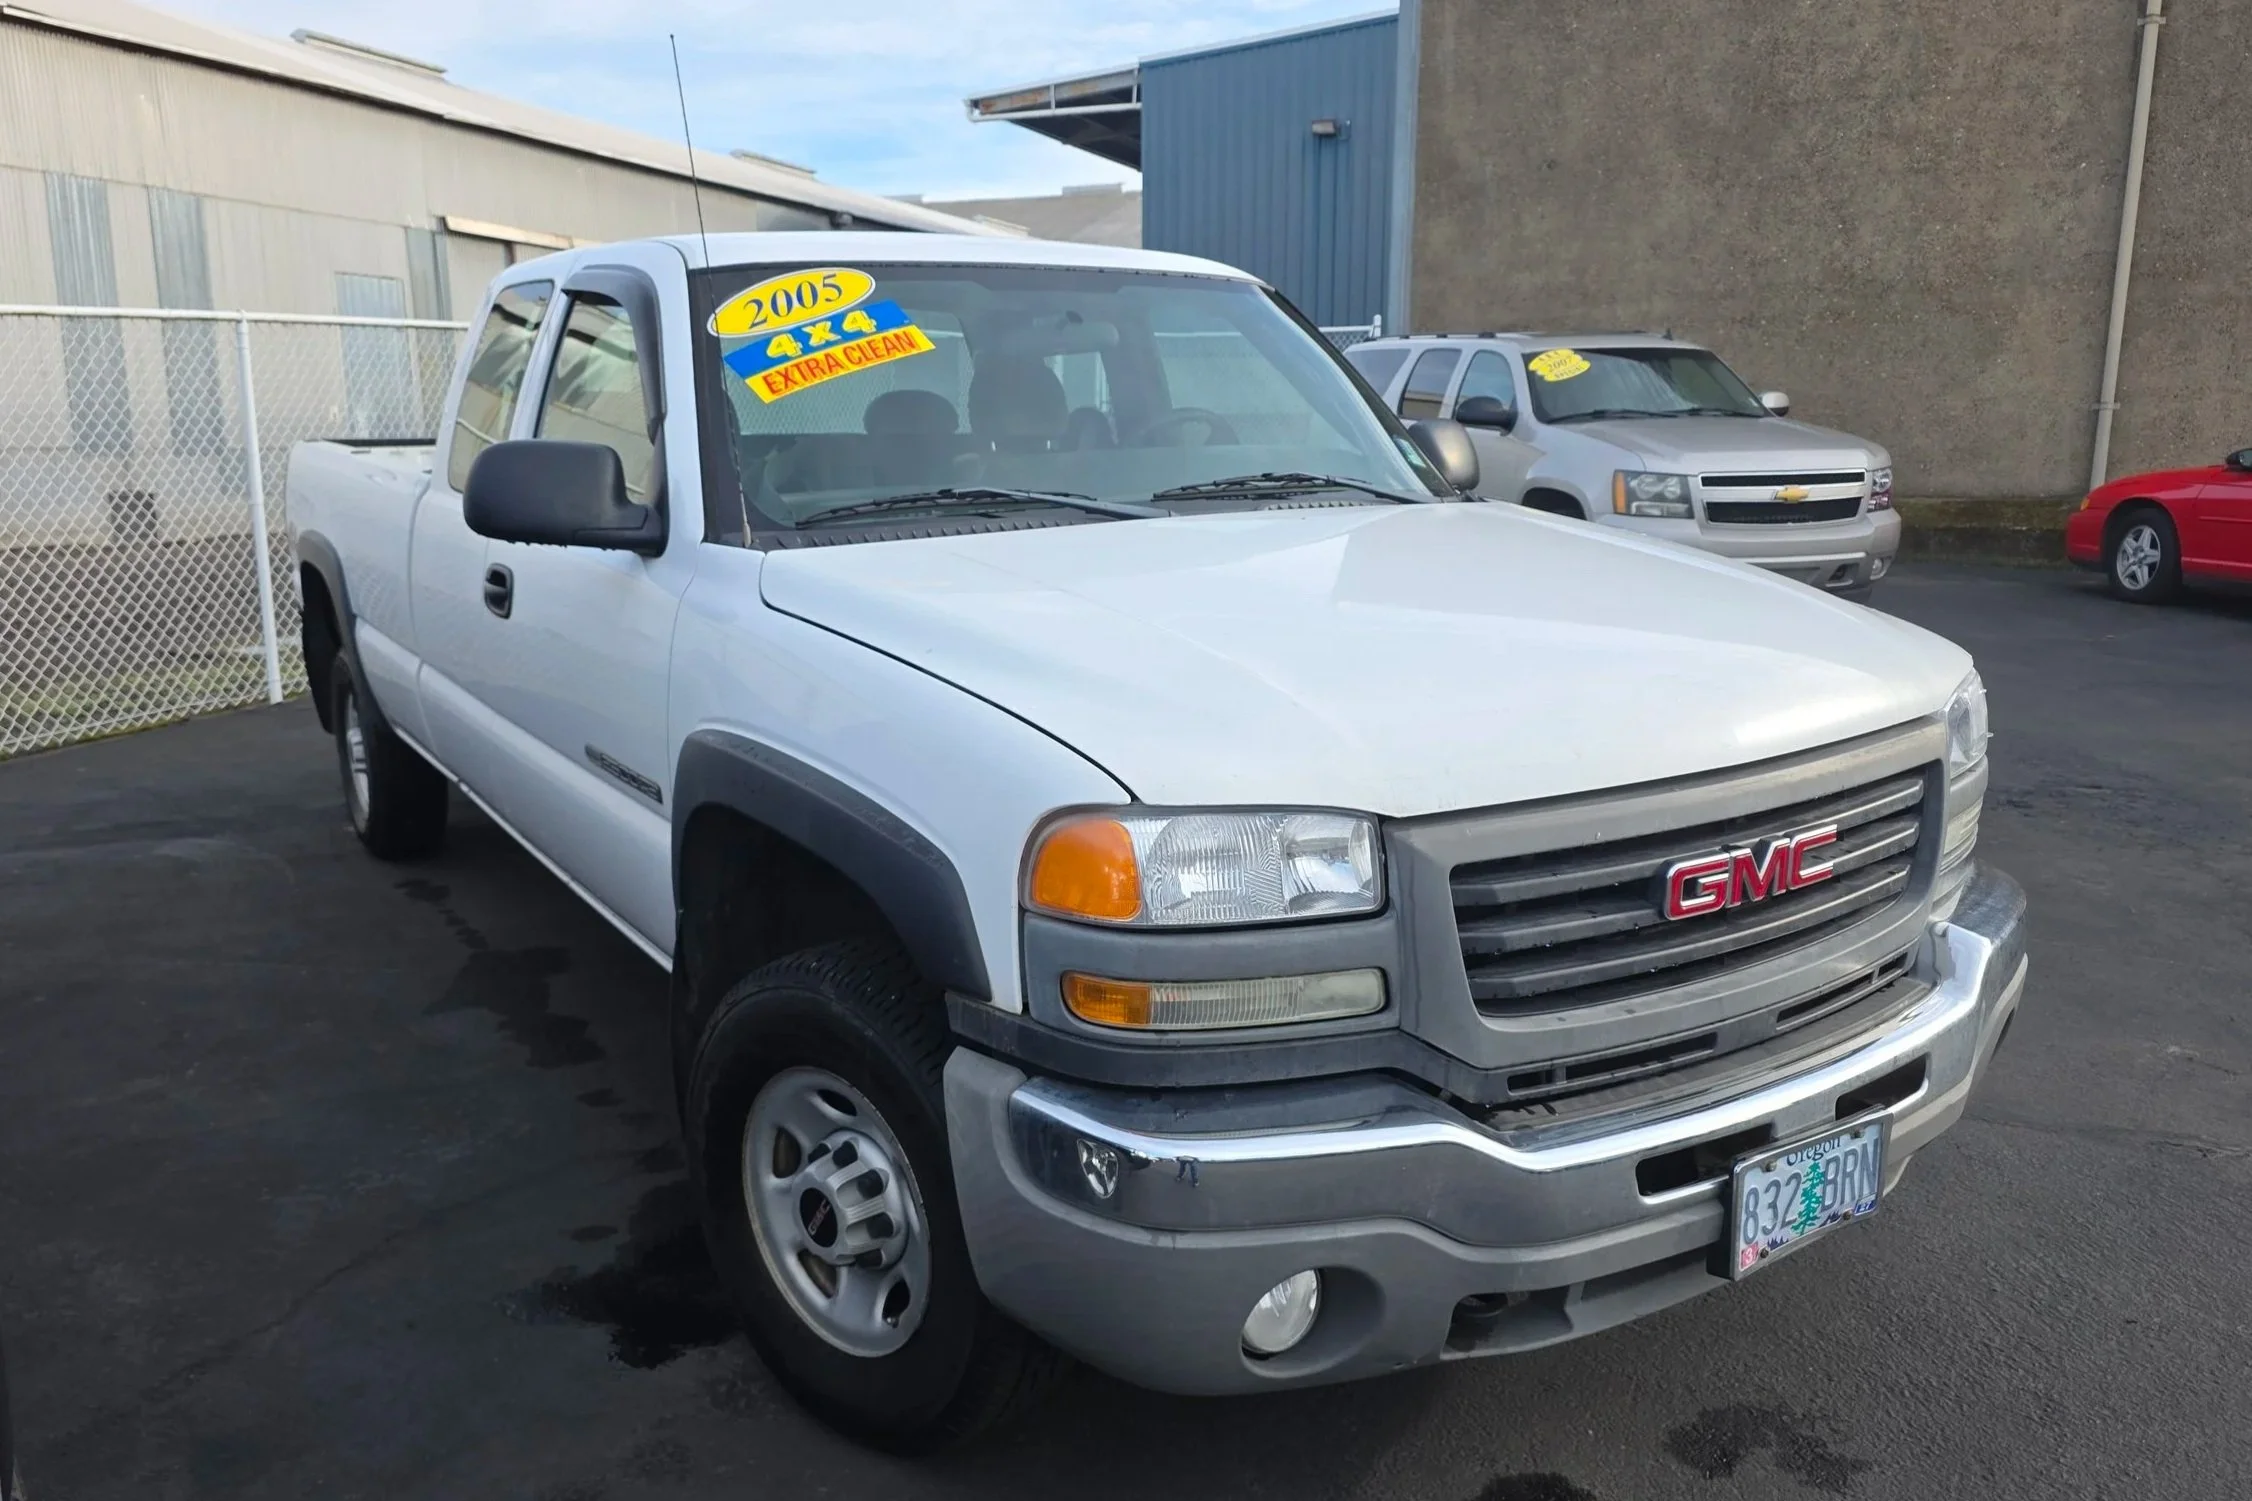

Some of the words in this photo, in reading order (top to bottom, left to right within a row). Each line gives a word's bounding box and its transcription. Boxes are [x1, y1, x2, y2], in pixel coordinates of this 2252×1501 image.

[743, 273, 843, 329] 2005
[762, 354, 844, 395] EXTRA
[843, 331, 916, 366] CLEAN
[1664, 824, 1838, 920] GMC
[1786, 1136, 1840, 1167] Oregon
[808, 1198, 832, 1236] GMC
[1743, 1170, 1802, 1245] 832
[1820, 1138, 1879, 1212] BRN
